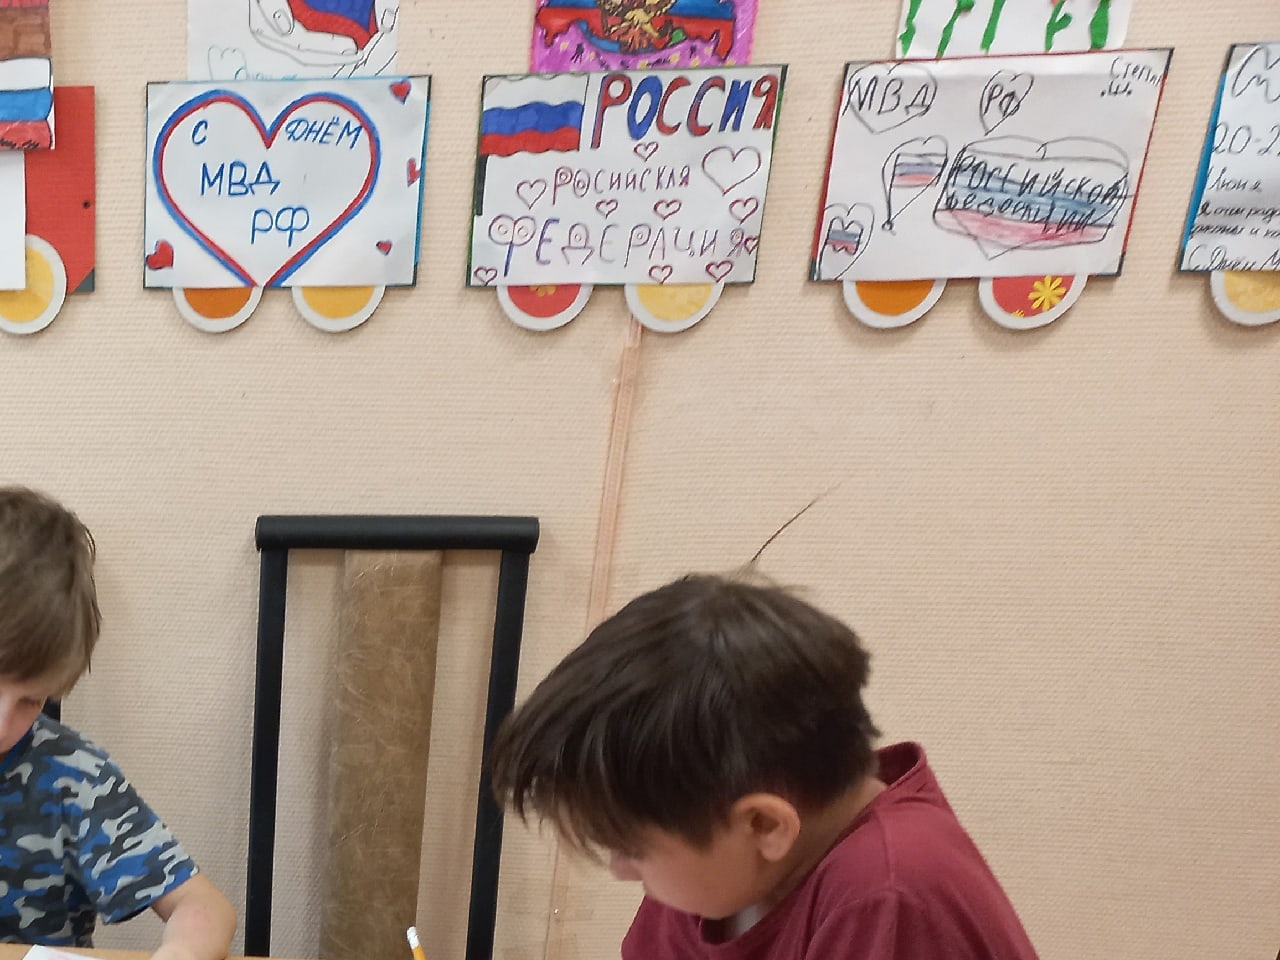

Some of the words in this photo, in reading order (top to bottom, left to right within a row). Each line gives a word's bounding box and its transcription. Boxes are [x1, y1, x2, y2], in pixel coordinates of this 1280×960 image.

[590, 73, 779, 149] РОССИЯ
[842, 74, 930, 115] МВД
[191, 120, 209, 146] С
[285, 116, 363, 150] ДНЁМ
[200, 161, 281, 197] МВД
[250, 206, 310, 247] РФ
[488, 213, 745, 277] ФЕДЕРАЦИЯ
